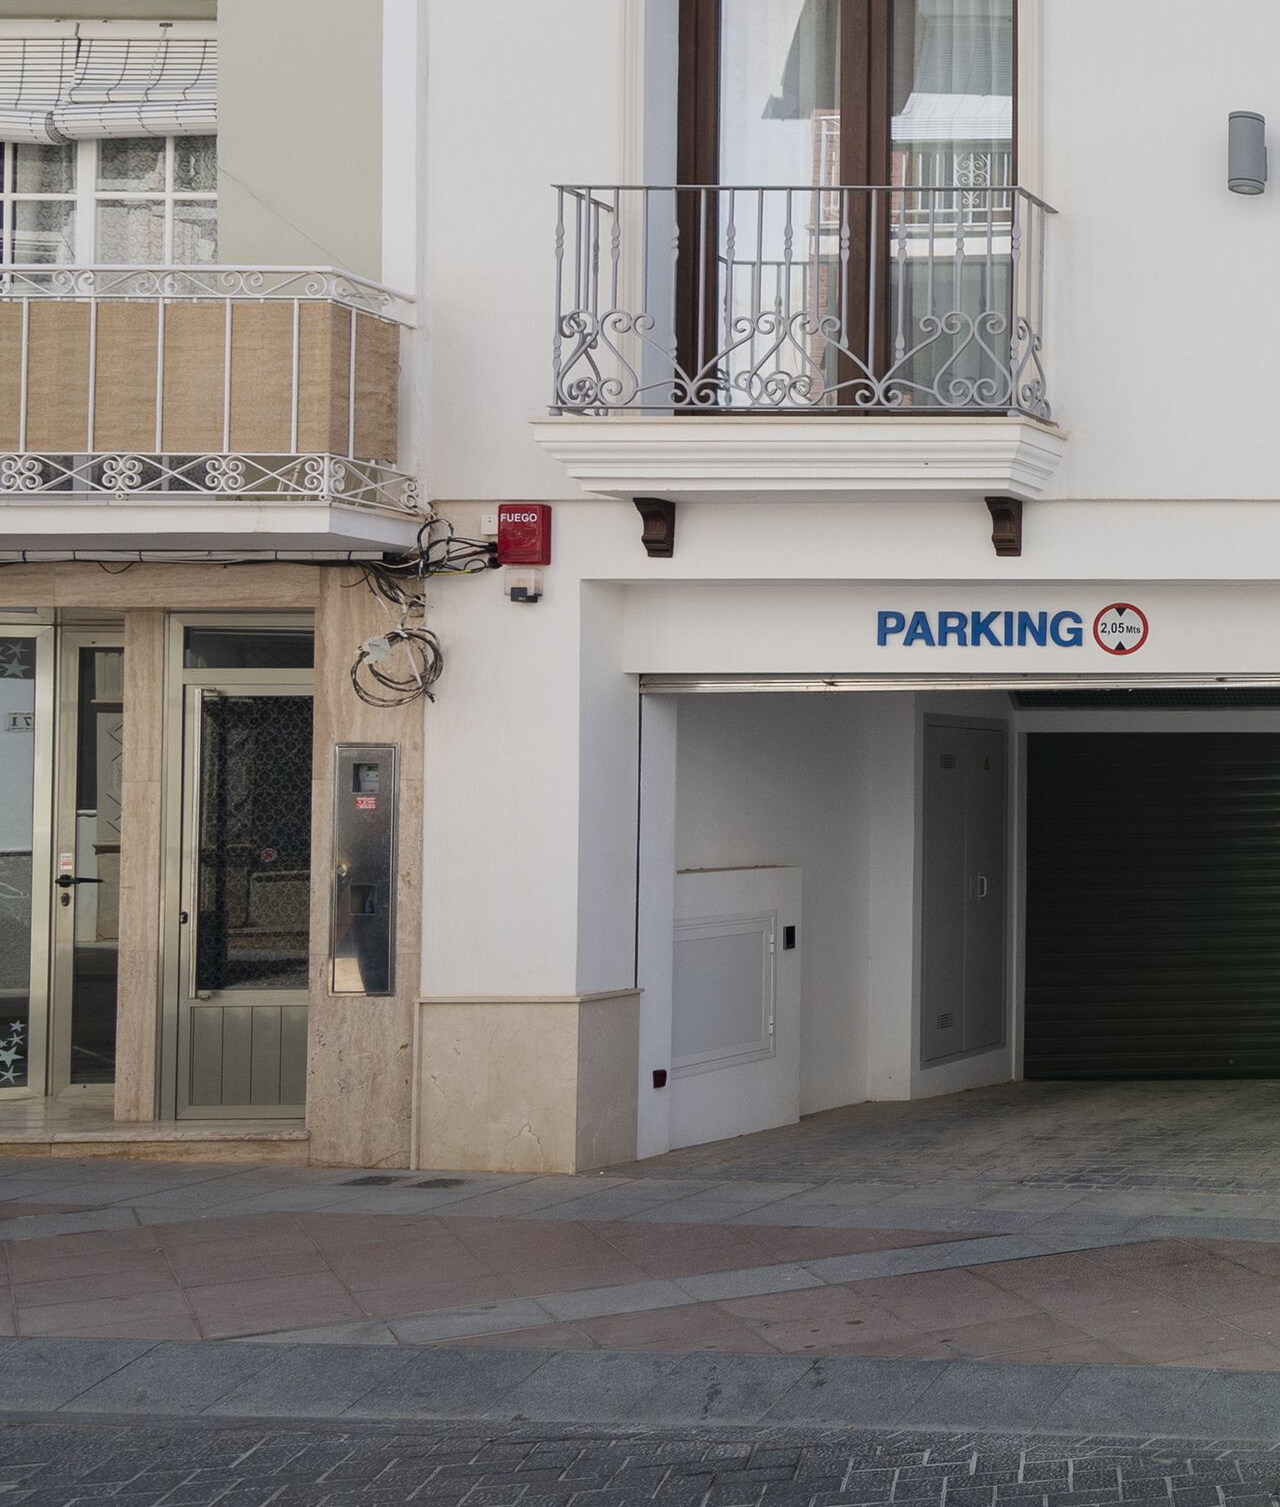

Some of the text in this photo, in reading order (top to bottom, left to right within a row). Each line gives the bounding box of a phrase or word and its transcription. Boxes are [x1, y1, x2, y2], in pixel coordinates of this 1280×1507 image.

[499, 513, 538, 523] FUEGO
[876, 610, 1083, 647] PARKING
[1100, 622, 1125, 636] 2,05
